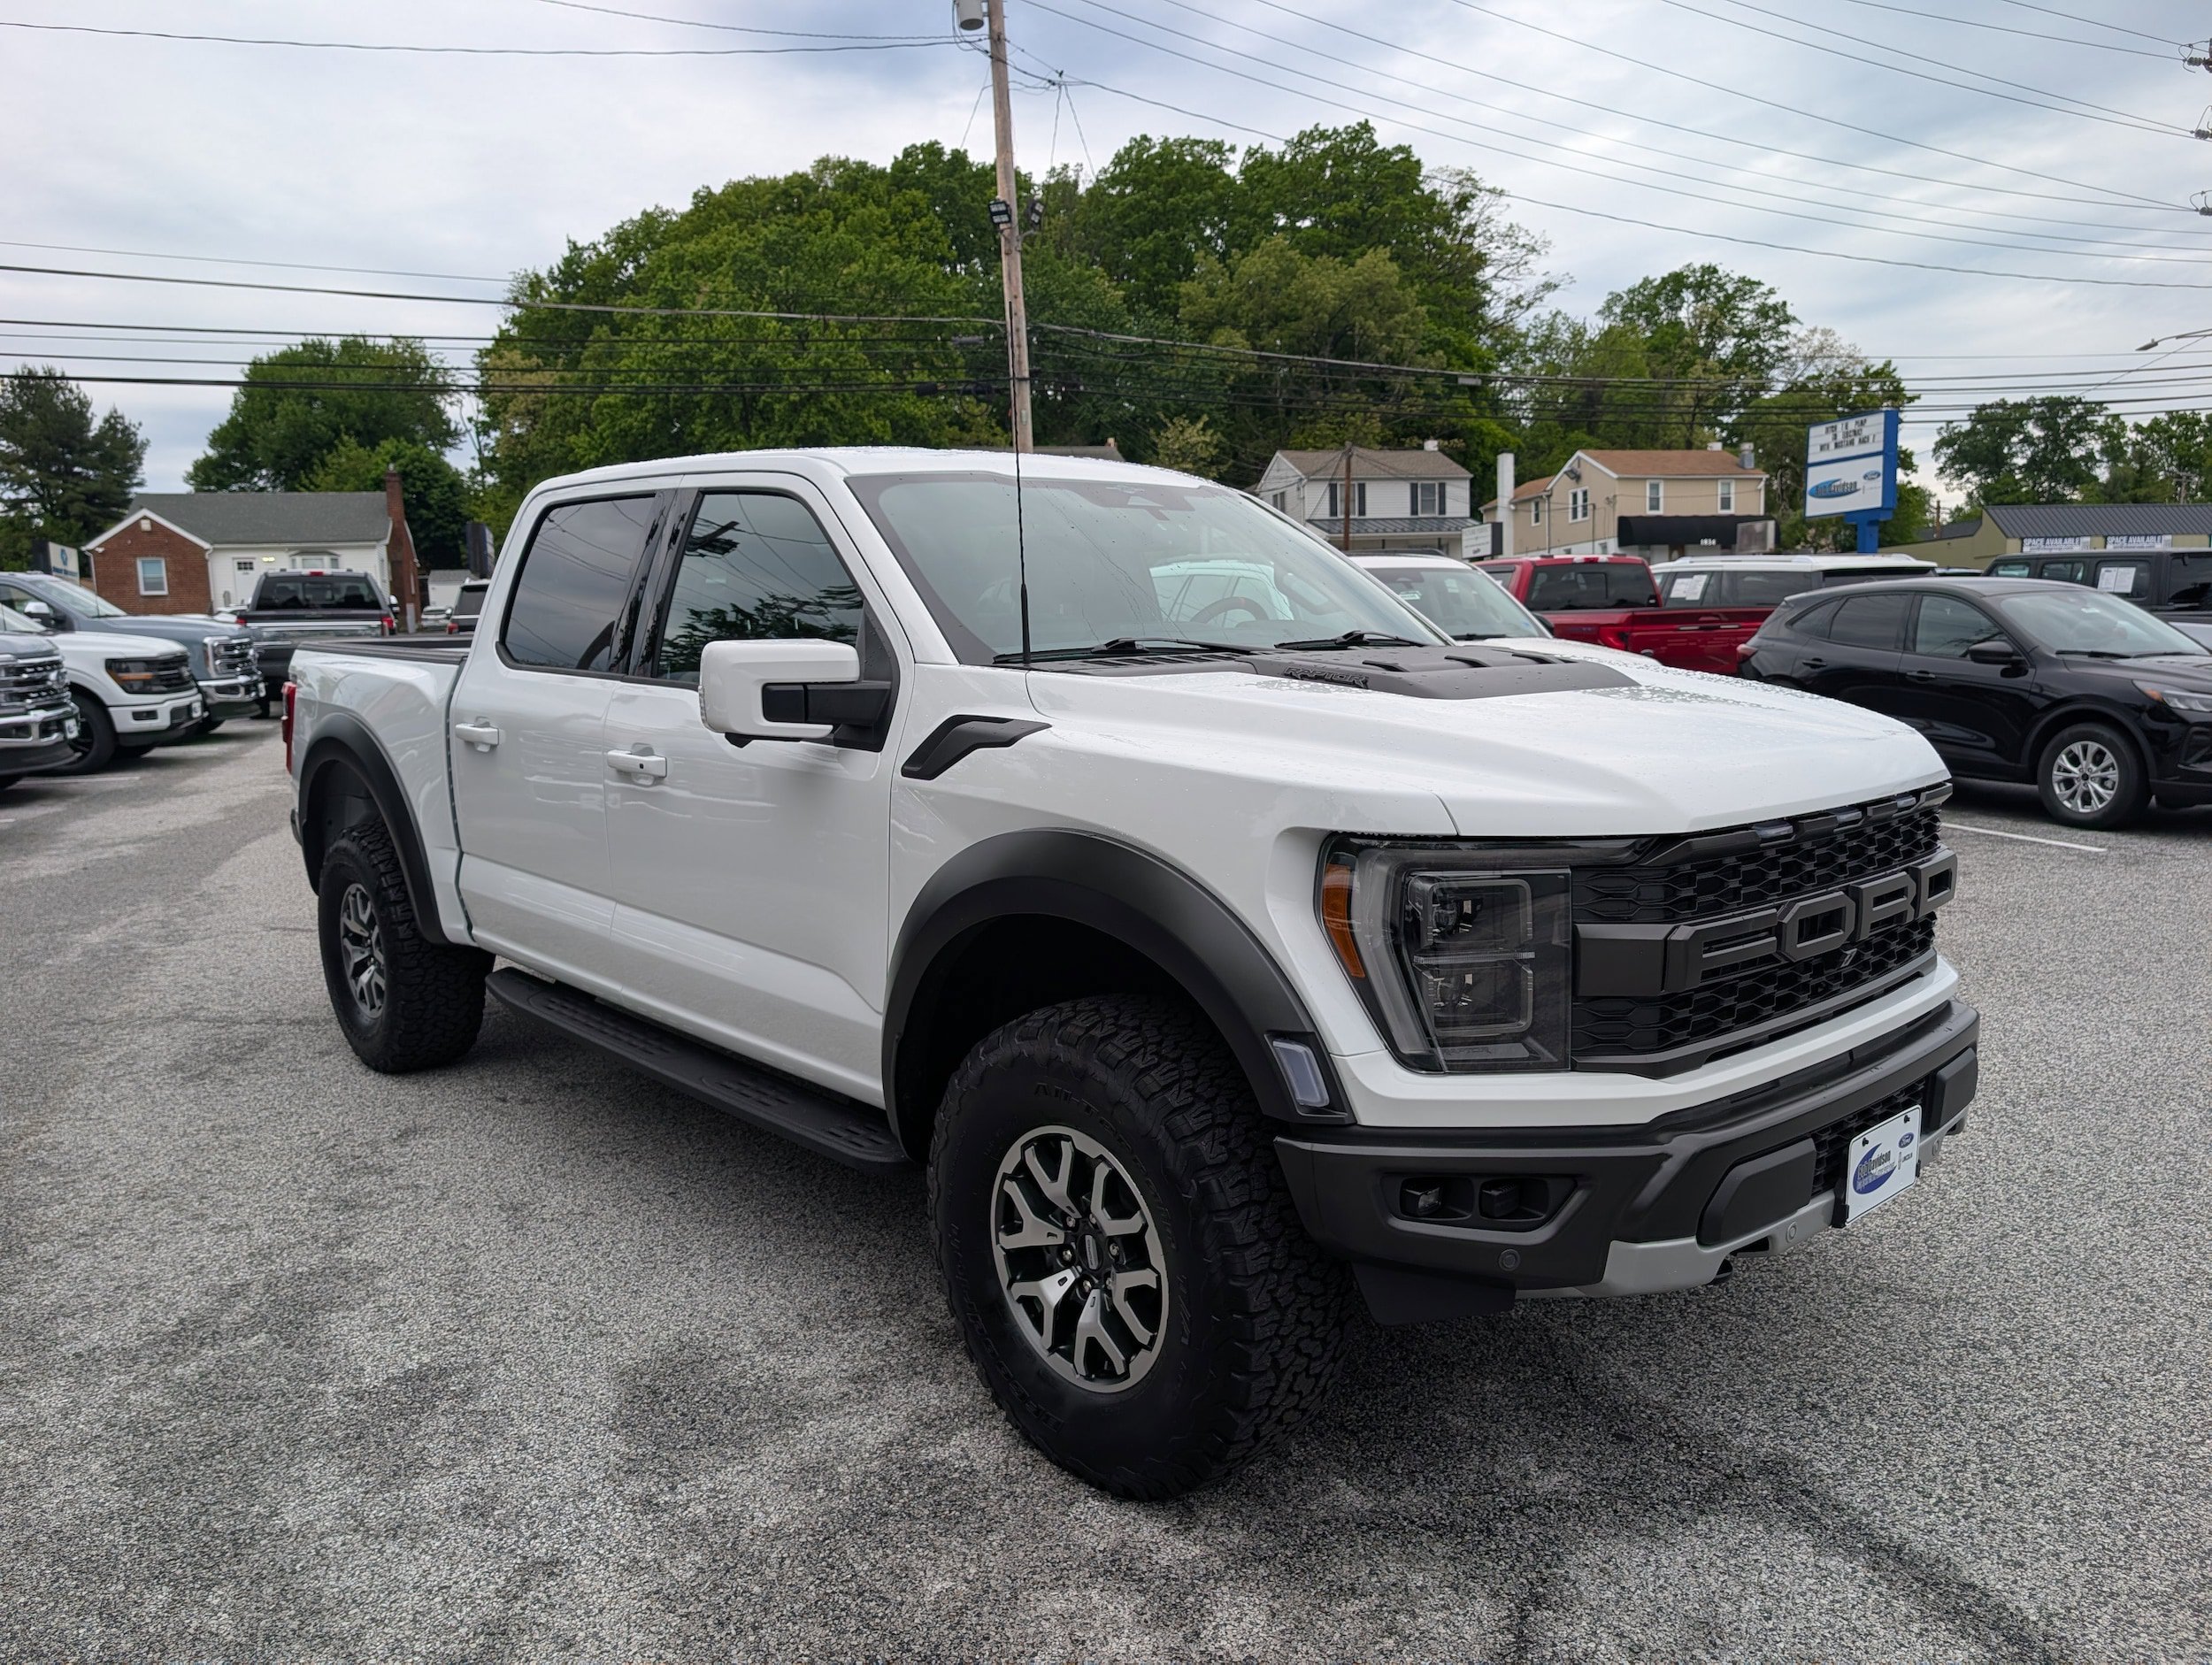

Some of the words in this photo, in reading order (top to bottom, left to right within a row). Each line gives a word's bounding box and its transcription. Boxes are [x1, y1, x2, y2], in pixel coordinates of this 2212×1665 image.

[2023, 537, 2045, 546] SPACE
[2045, 536, 2080, 546] AVAILABLE
[2107, 536, 2128, 545] SPACE
[2128, 534, 2162, 544] AVAILABLE
[1284, 666, 1369, 689] RAPTOR
[1665, 850, 1958, 995] FORD
